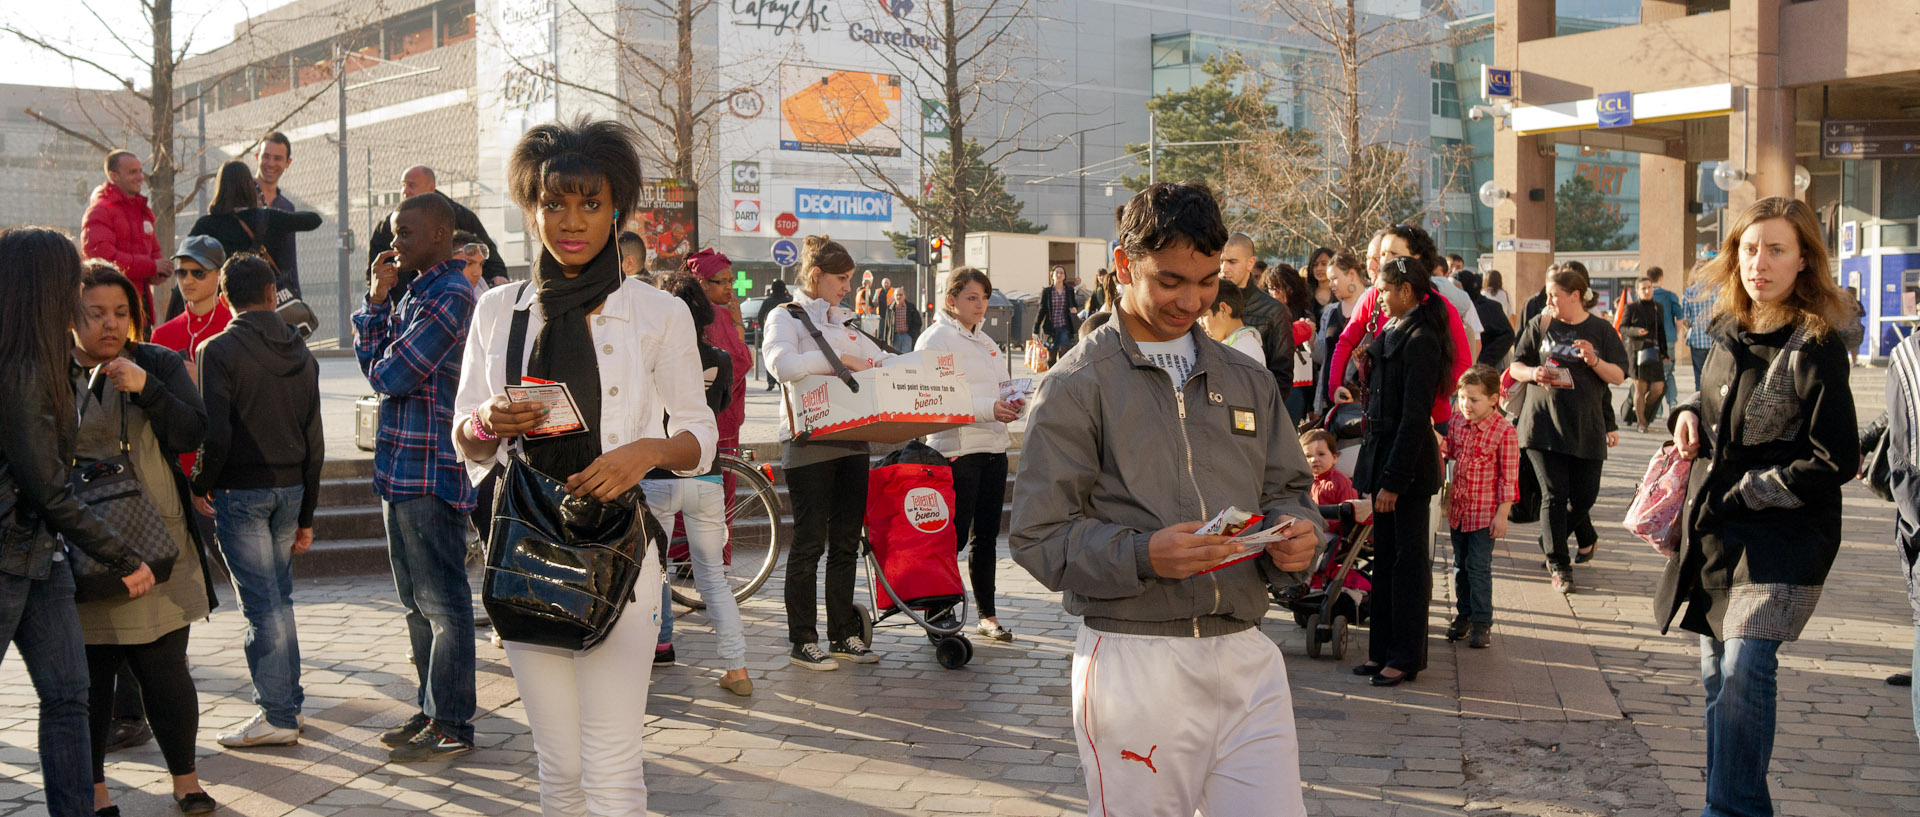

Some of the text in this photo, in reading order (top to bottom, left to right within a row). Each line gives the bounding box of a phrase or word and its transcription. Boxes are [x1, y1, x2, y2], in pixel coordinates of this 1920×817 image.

[849, 22, 940, 50] Carrefour
[1489, 73, 1510, 85] LCL
[1597, 98, 1627, 112] LCL
[733, 164, 759, 184] GO
[656, 186, 667, 202] LE
[667, 187, 684, 202] LOU
[799, 193, 889, 217] DECATHLON
[735, 210, 759, 221] DARTY
[776, 219, 797, 230] STOP
[939, 370, 955, 378] bueno
[805, 408, 830, 428] bueno
[911, 491, 941, 512] Tellement
[915, 511, 940, 522] bueno
